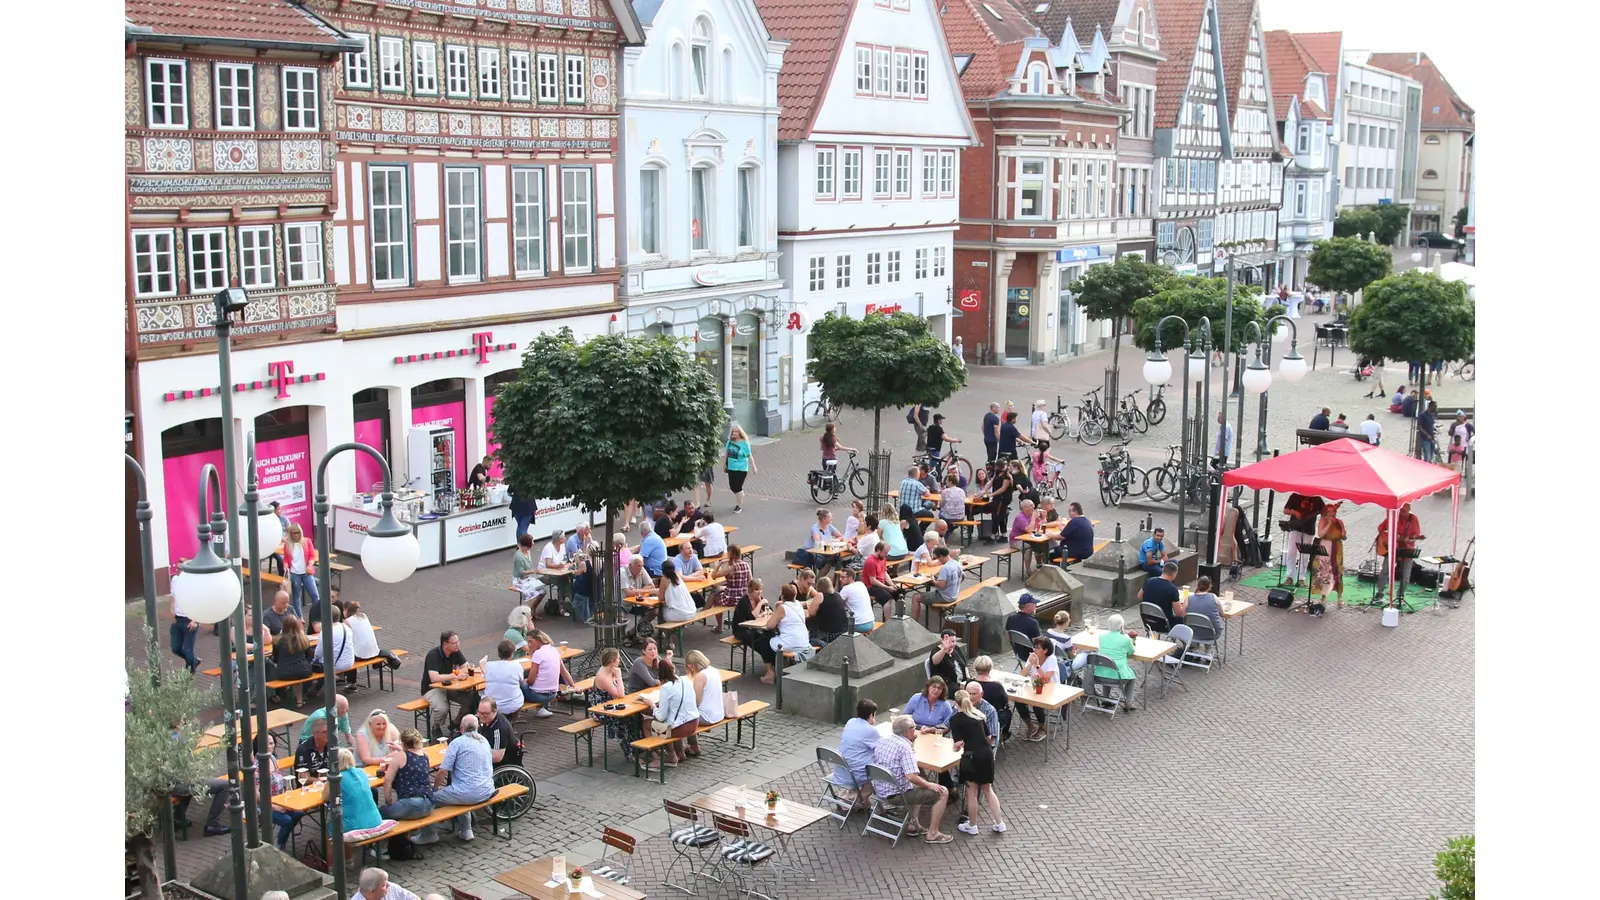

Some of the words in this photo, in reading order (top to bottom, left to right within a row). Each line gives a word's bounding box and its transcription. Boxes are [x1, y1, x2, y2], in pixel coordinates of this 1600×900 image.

[472, 332, 492, 364] T
[268, 360, 294, 398] T
[271, 456, 278, 464] IN
[278, 452, 306, 464] ZUKUNFT
[262, 476, 281, 484] IHRER
[282, 470, 298, 480] SEITE
[264, 464, 286, 476] IMMER
[286, 462, 295, 470] AN
[458, 522, 481, 534] Getränke
[482, 516, 507, 528] DAMKE
